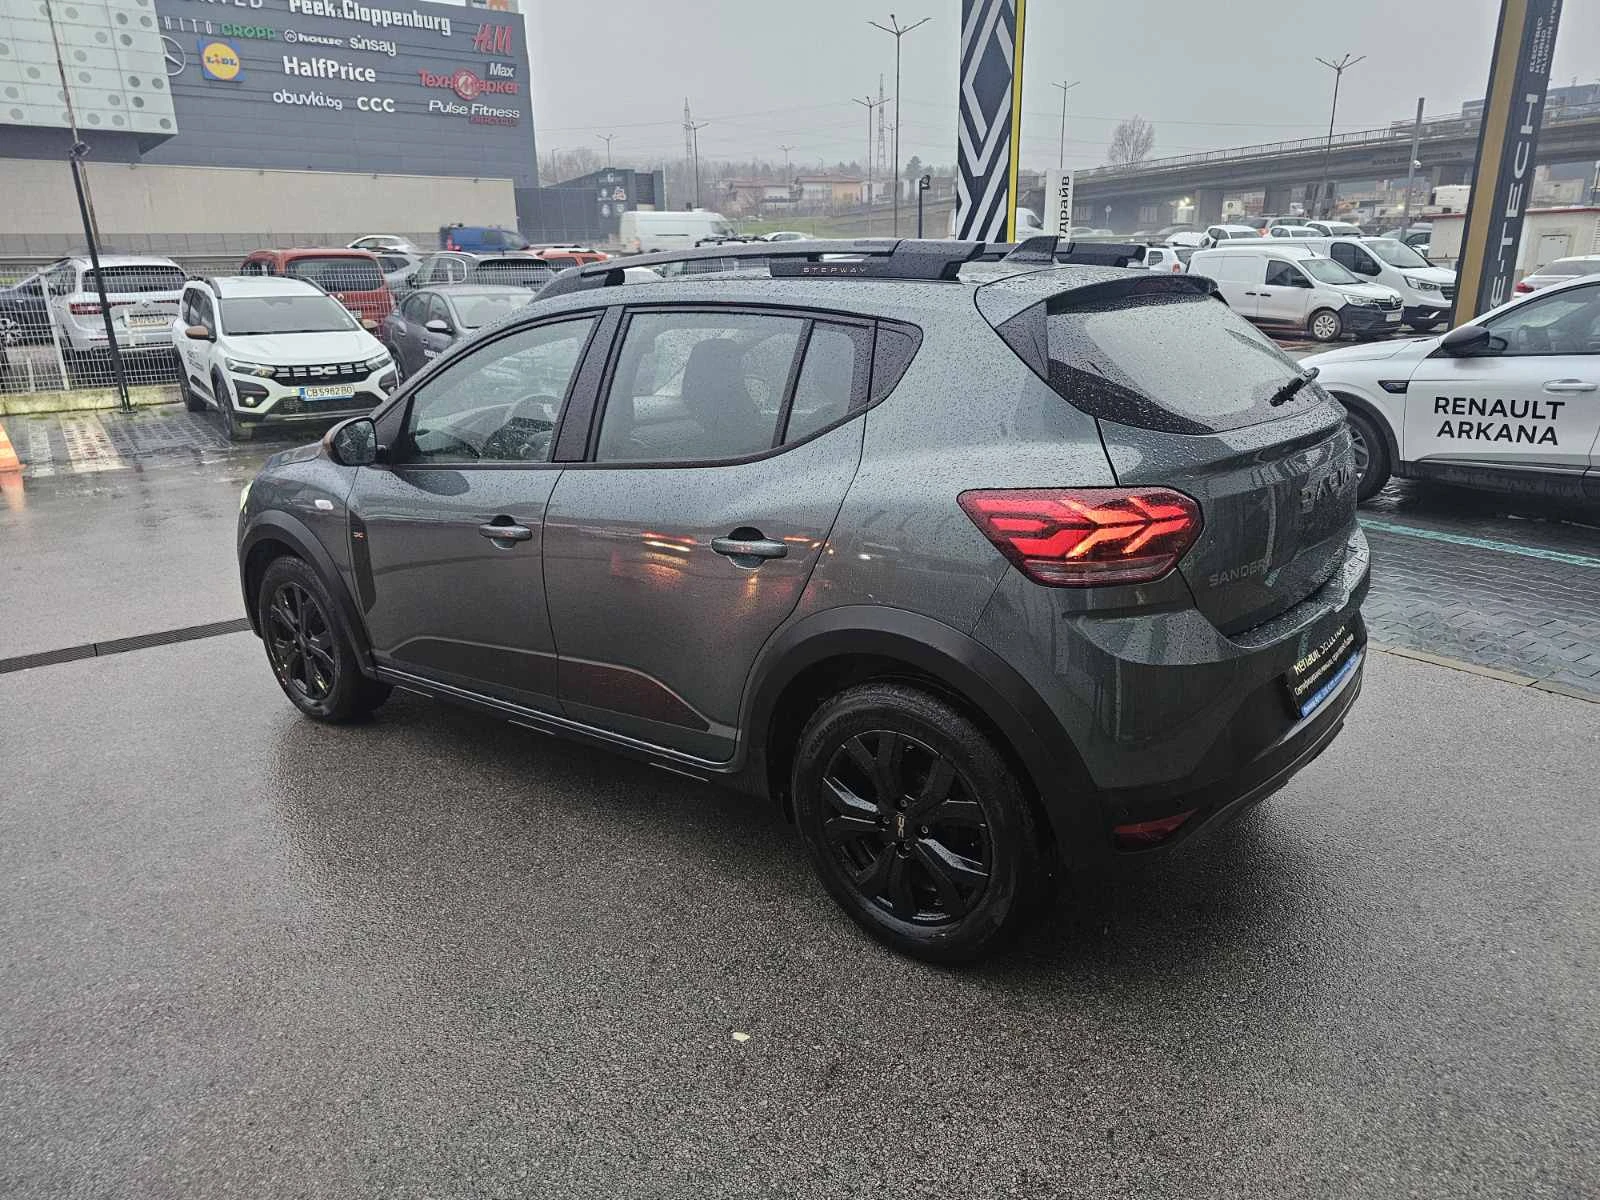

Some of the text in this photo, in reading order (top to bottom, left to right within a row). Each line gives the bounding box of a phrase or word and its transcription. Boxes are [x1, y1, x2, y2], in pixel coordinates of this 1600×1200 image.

[472, 23, 513, 56] H&M
[282, 56, 376, 82] HalfPrice
[489, 62, 514, 77] Max
[273, 89, 343, 111] obuvki.bg
[357, 97, 396, 112] CCC
[429, 100, 520, 118] Pulse Fitness
[1434, 396, 1566, 421] RENAULT
[1436, 420, 1559, 446] ARKANA
